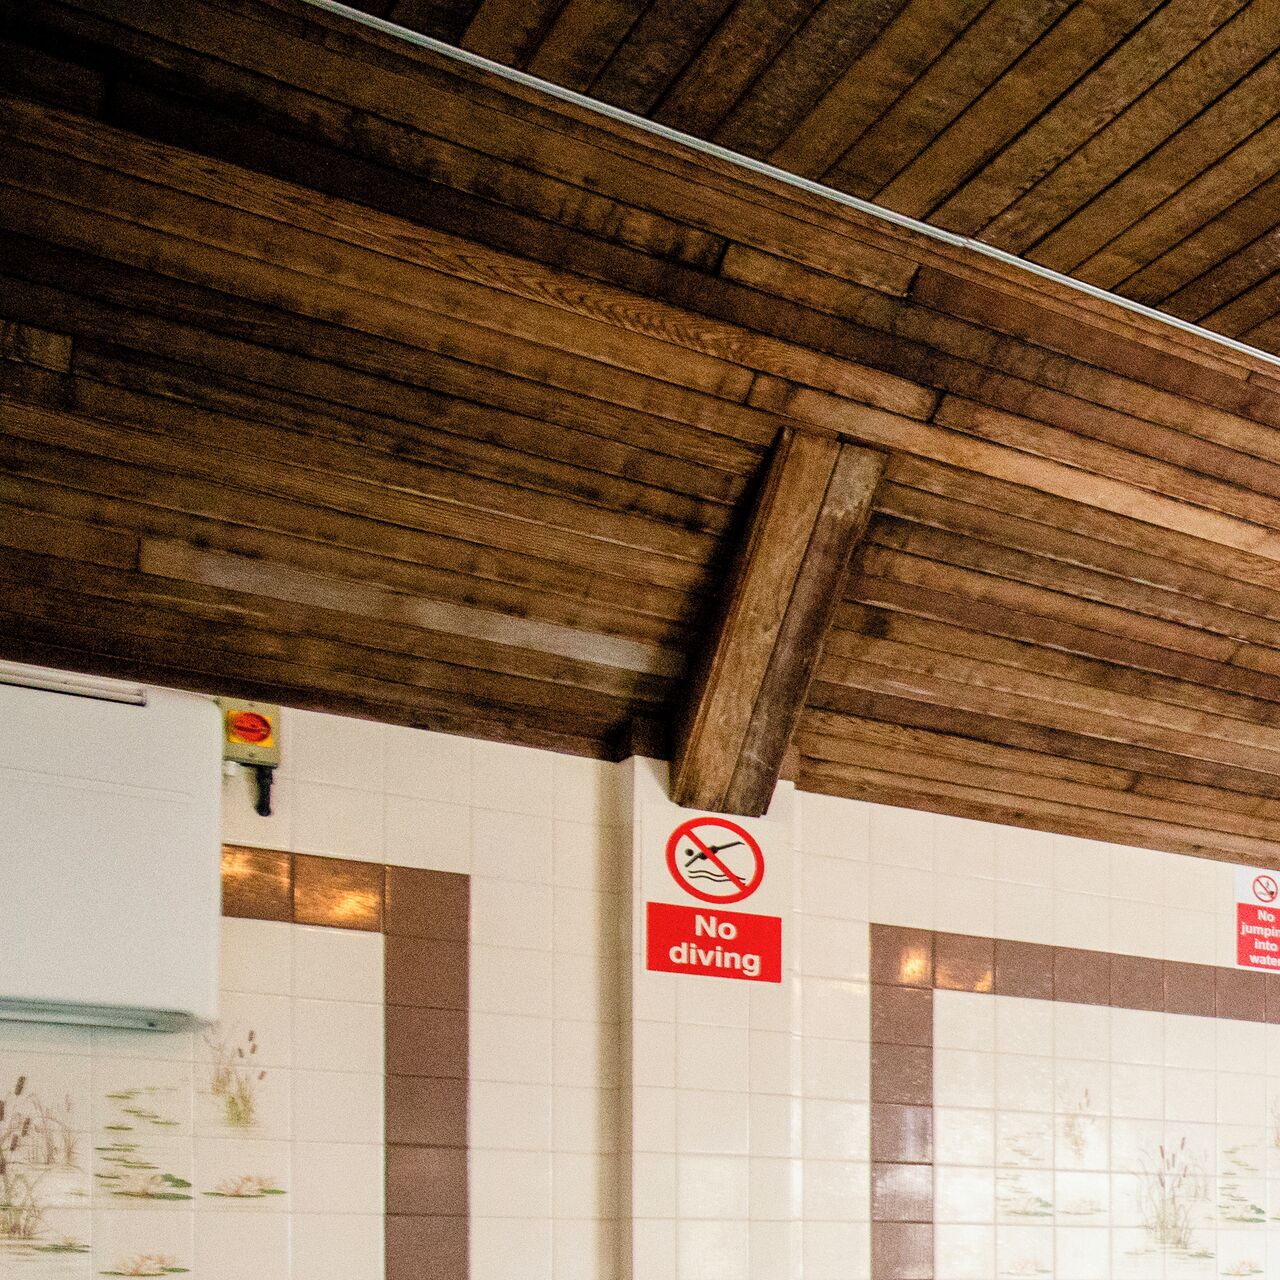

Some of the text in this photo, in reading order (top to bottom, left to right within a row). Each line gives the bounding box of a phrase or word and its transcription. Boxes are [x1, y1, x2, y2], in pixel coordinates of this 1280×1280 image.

[1257, 909, 1275, 922] No
[695, 914, 737, 940] No
[1254, 939, 1278, 951] into
[669, 942, 761, 976] diving
